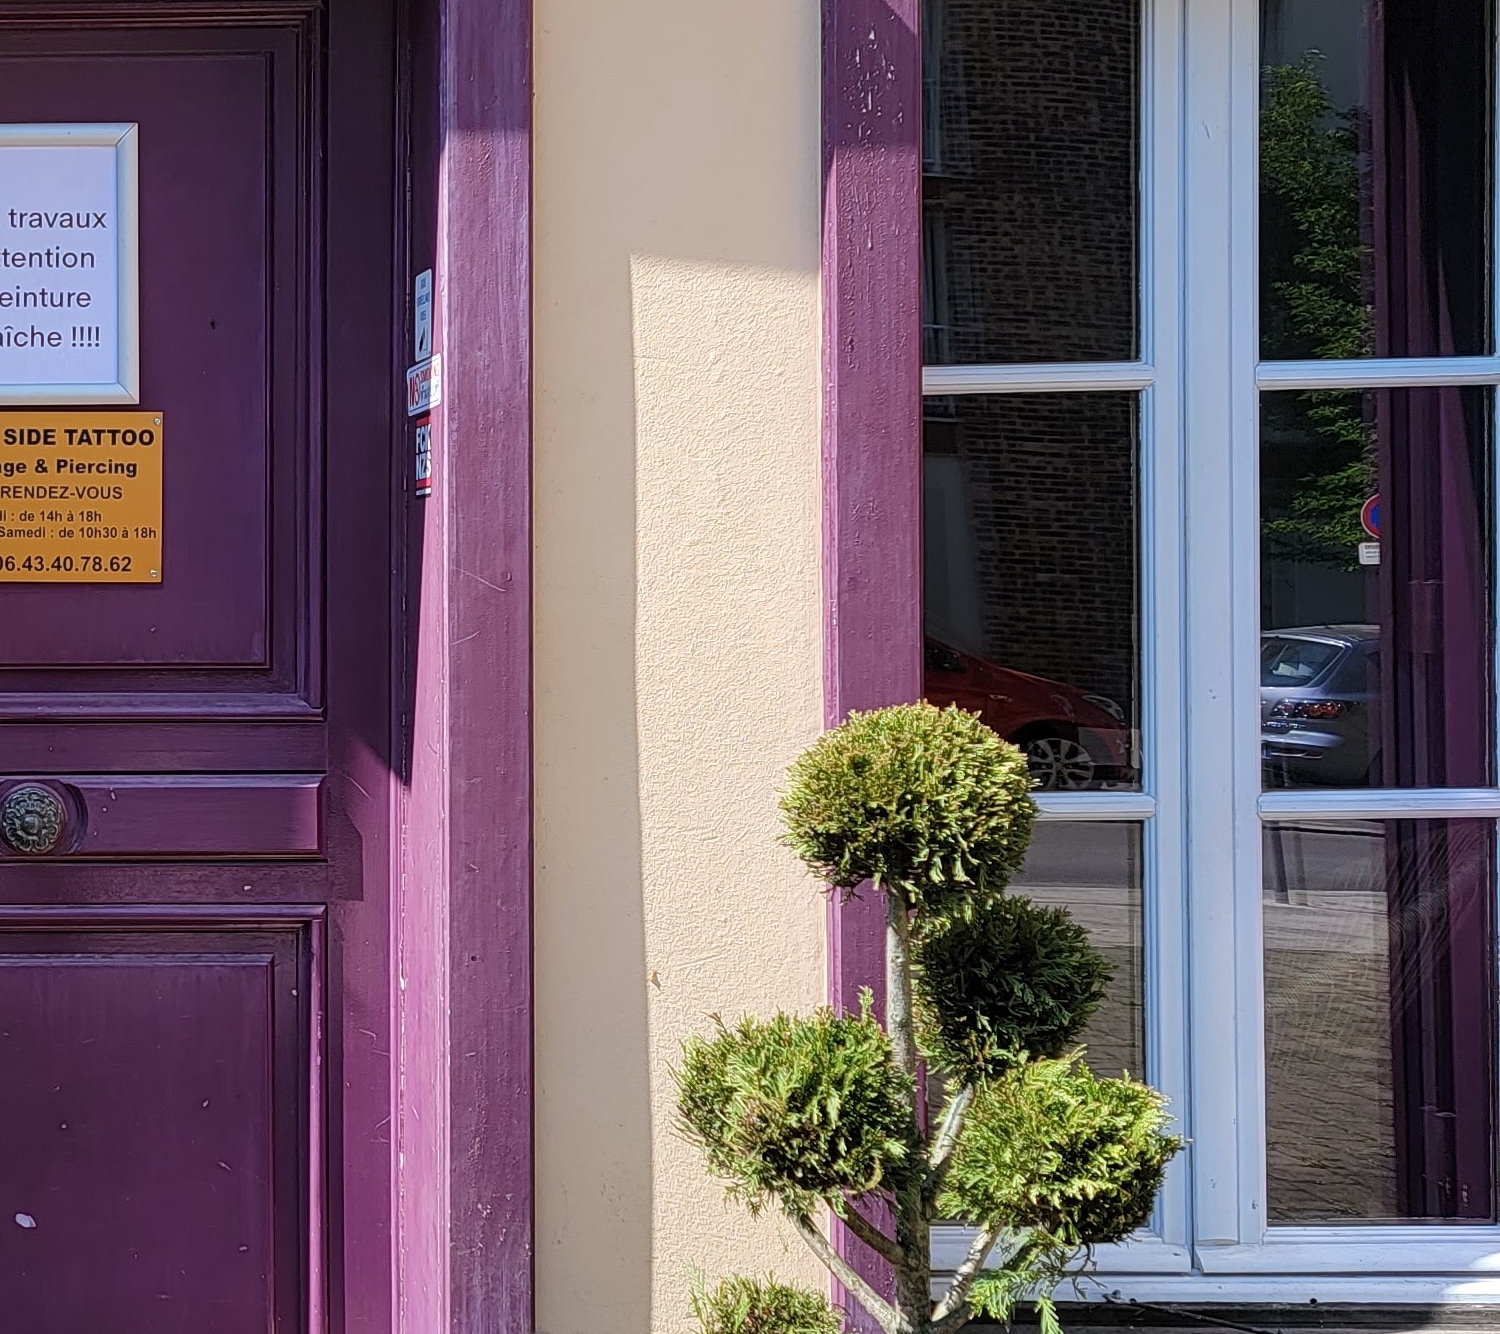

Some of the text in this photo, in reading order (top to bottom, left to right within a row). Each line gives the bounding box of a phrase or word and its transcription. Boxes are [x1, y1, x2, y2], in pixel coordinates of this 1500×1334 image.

[8, 209, 107, 228] travaux
[4, 429, 56, 445] SIDE
[64, 429, 154, 446] TATTOO
[416, 424, 431, 453] FCK
[35, 459, 48, 473] &
[57, 459, 137, 478] Piercing
[416, 451, 431, 480] NZS
[1, 486, 122, 499] RENDEZ-VOUS
[19, 510, 35, 521] de
[40, 510, 62, 522] 14h
[67, 510, 74, 522] à
[79, 511, 101, 522] 18h
[59, 527, 74, 538] de
[79, 527, 117, 538] 10h30
[122, 527, 128, 538] à
[134, 527, 156, 538] 18h
